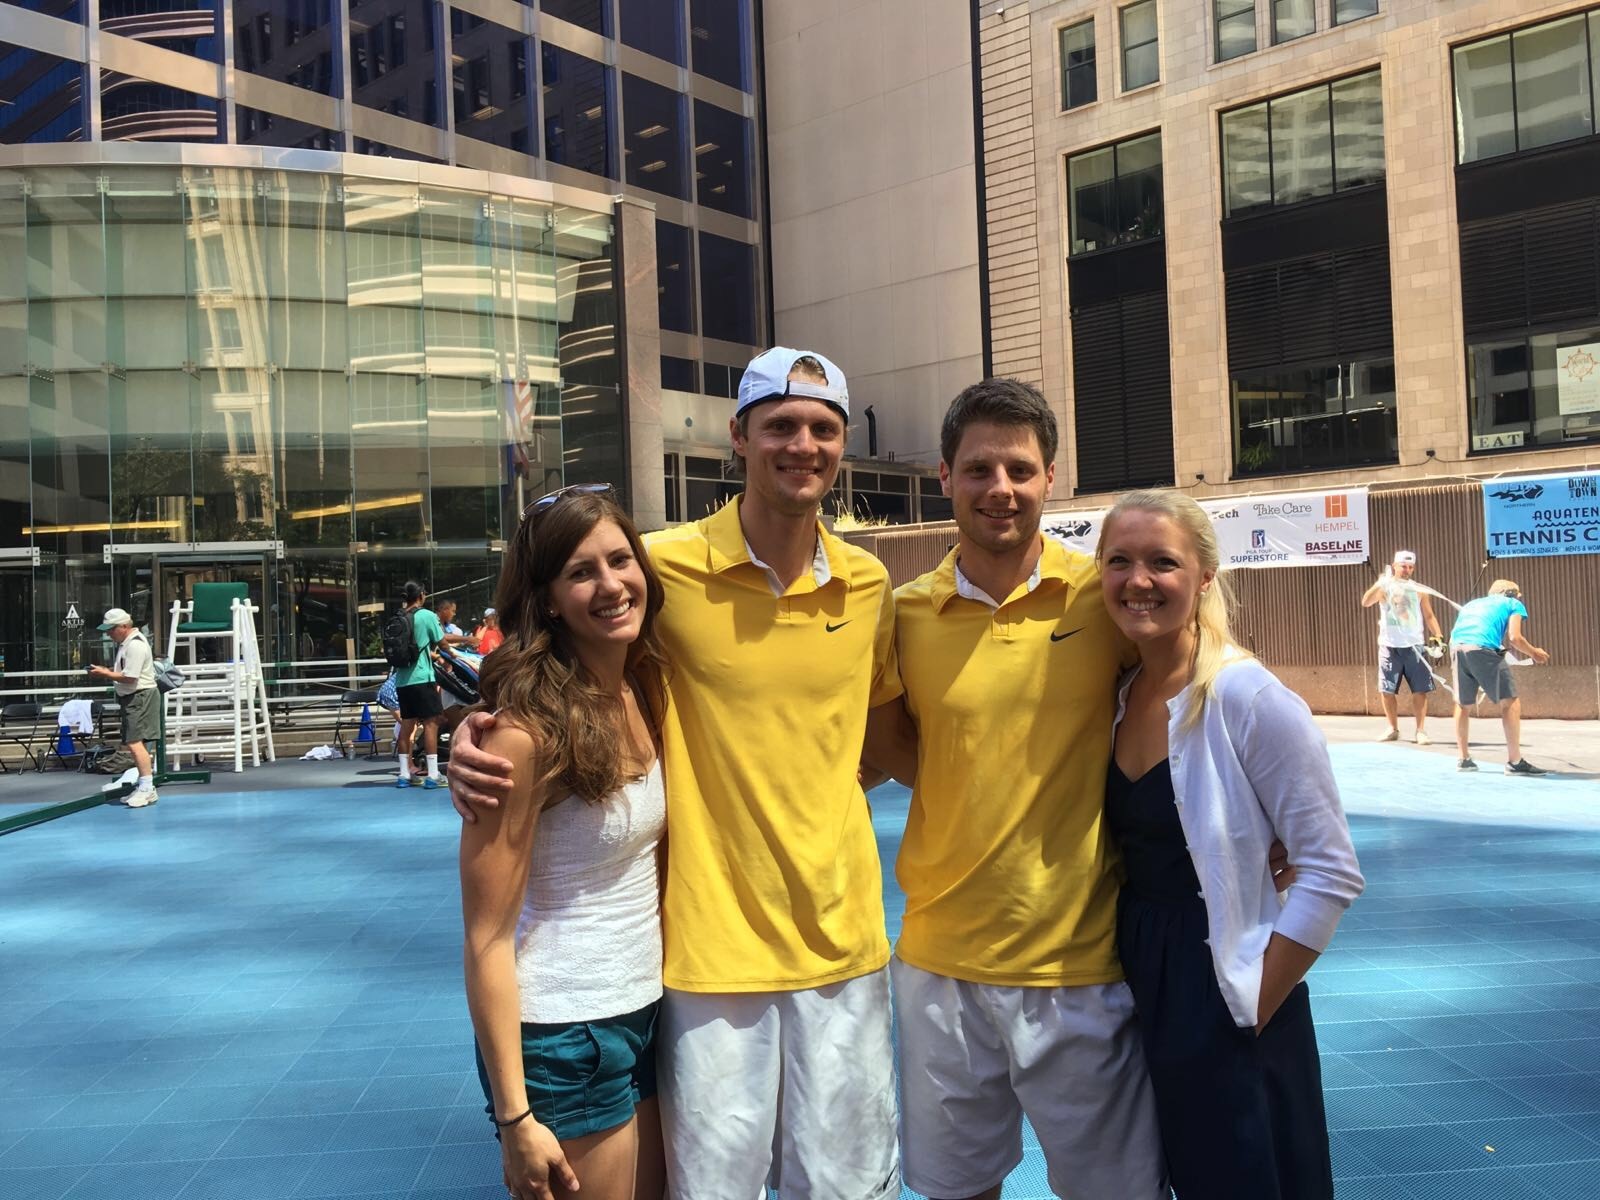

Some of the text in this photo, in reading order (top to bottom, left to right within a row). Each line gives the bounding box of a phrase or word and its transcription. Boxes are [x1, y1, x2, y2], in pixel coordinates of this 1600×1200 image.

[1480, 434, 1520, 448] EAT
[1253, 504, 1280, 516] Take
[1282, 502, 1312, 514] Care
[1532, 506, 1599, 521] AQUATEN
[1315, 521, 1359, 533] HEMPEL
[1490, 528, 1577, 546] TENNIS
[1305, 540, 1362, 553] BASELINE
[1230, 553, 1289, 563] SUPERSTORE
